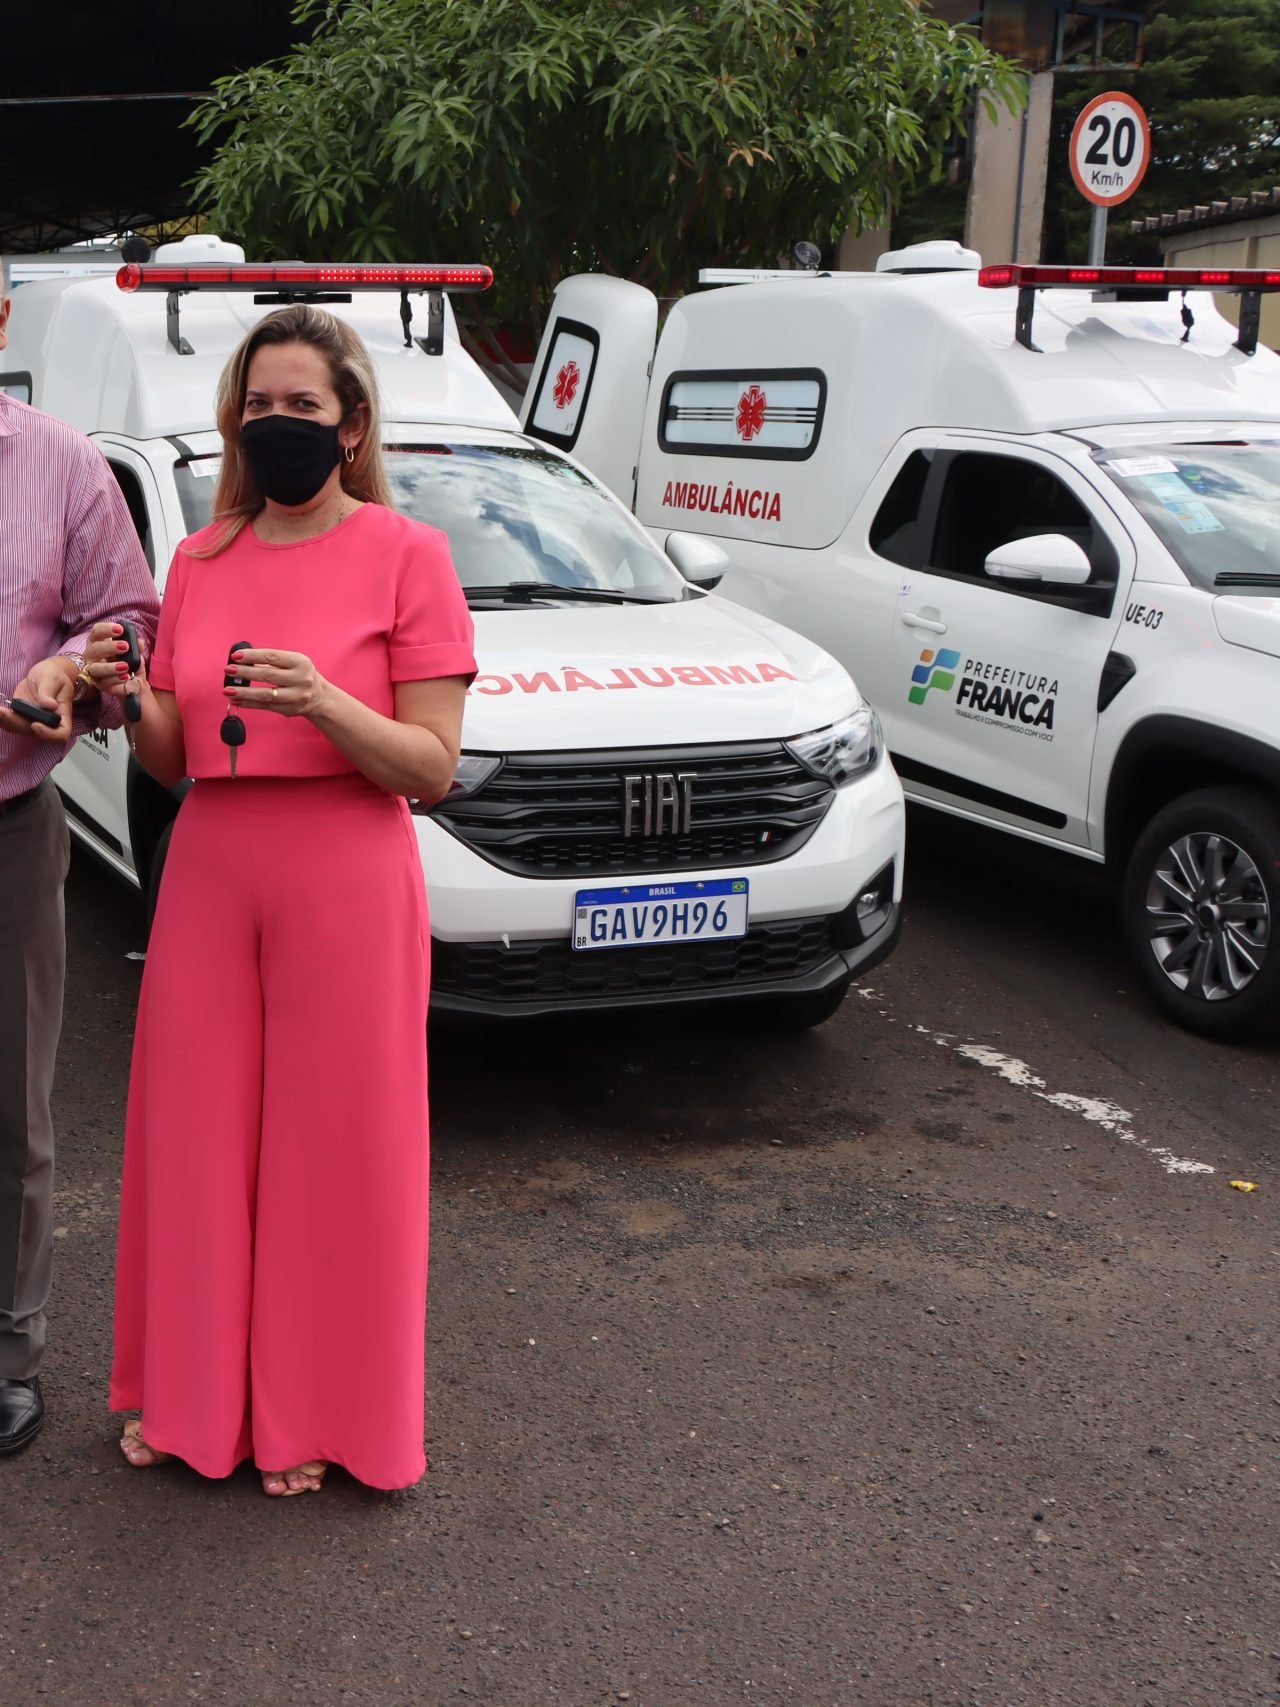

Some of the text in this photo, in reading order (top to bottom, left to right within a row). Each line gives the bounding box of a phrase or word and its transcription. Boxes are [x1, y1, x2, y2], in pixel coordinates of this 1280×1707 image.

[1084, 114, 1136, 168] 20
[1091, 170, 1124, 187] Km/h
[662, 480, 781, 521] AMBULÂNCIA
[1125, 603, 1164, 630] UE-03
[963, 659, 1059, 697] PREFEITURA
[956, 677, 1055, 730] FRANCA
[624, 772, 698, 837] FIAT
[649, 887, 676, 896] BRASIL
[590, 900, 728, 942] GAV9H96
[577, 936, 587, 947] BR
